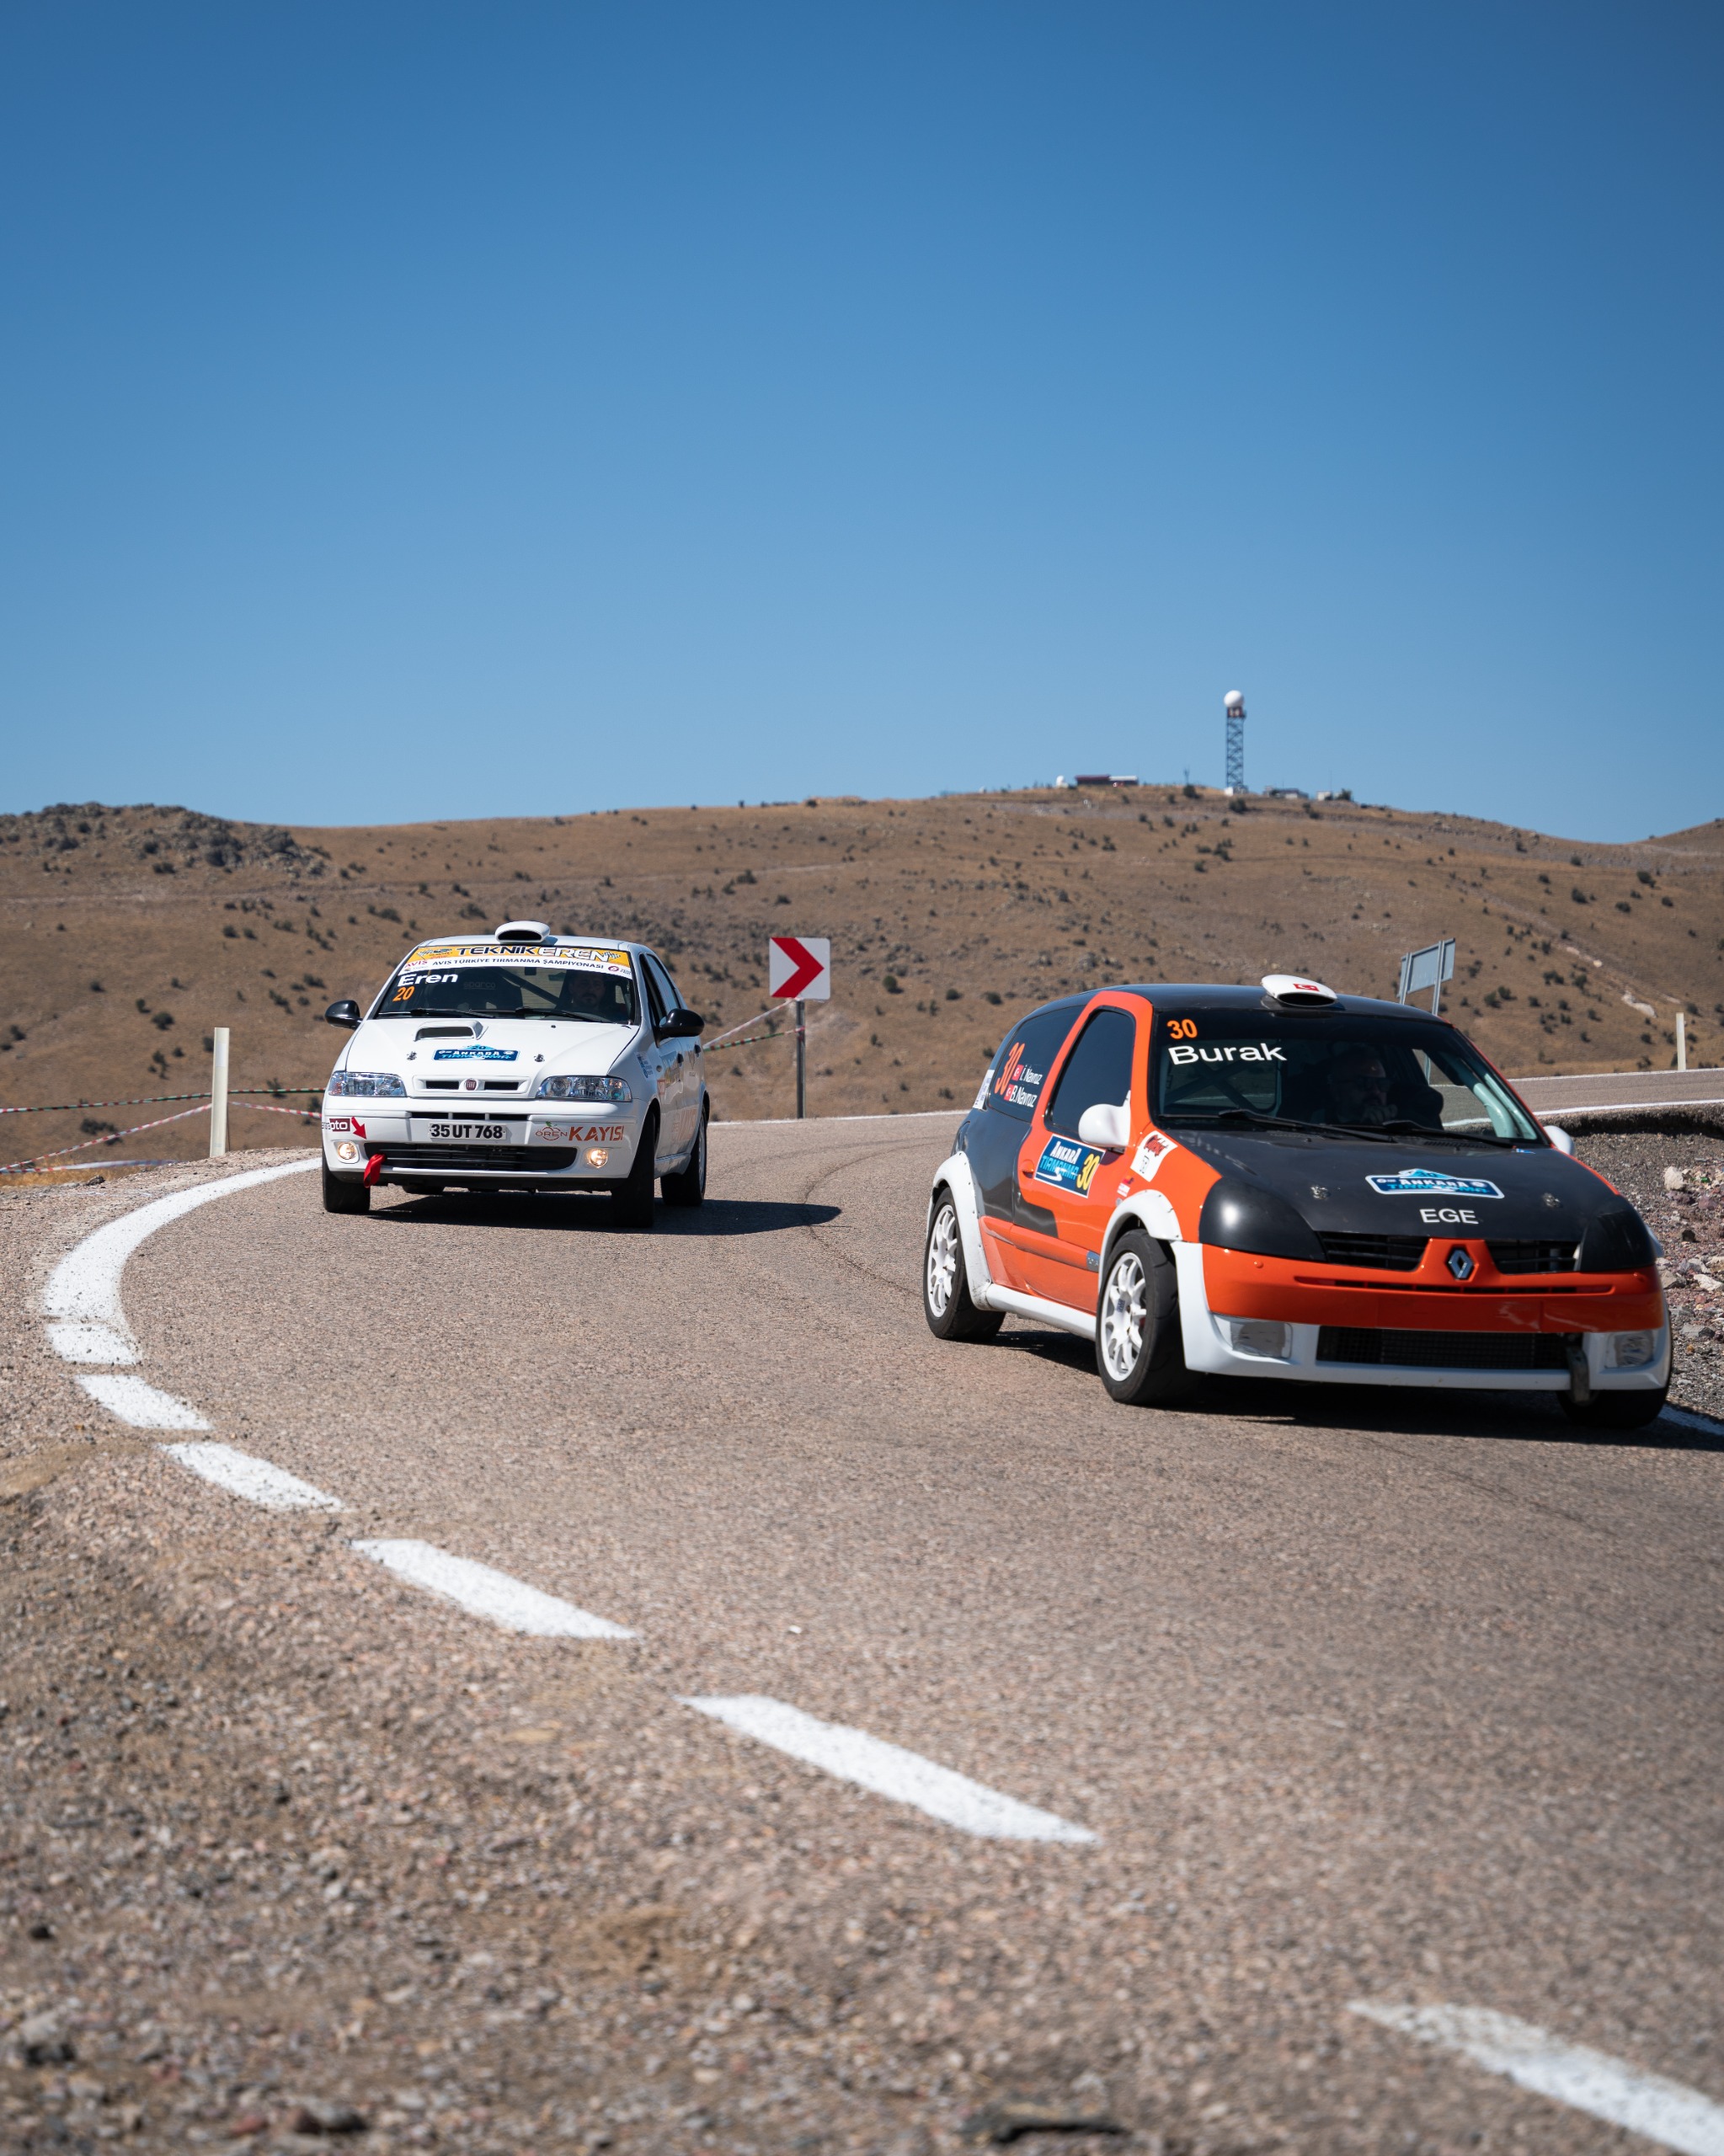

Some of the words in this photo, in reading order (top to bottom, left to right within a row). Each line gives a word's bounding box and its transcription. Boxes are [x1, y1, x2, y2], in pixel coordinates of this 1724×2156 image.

[543, 959, 604, 969] ŞAMPİYONASI
[398, 974, 458, 987] Eren
[392, 986, 415, 1002] 20
[1166, 1018, 1198, 1039] 30
[1167, 1043, 1288, 1065] Burak
[994, 1042, 1025, 1096] 30
[430, 1124, 451, 1137] 35
[452, 1125, 472, 1138] UT
[475, 1125, 503, 1139] 768
[568, 1125, 625, 1142] KAYISI
[1049, 1140, 1082, 1166] ANKARA
[1076, 1153, 1101, 1191] 30
[1400, 1179, 1469, 1187] ANKARA
[1419, 1209, 1480, 1225] EGE
